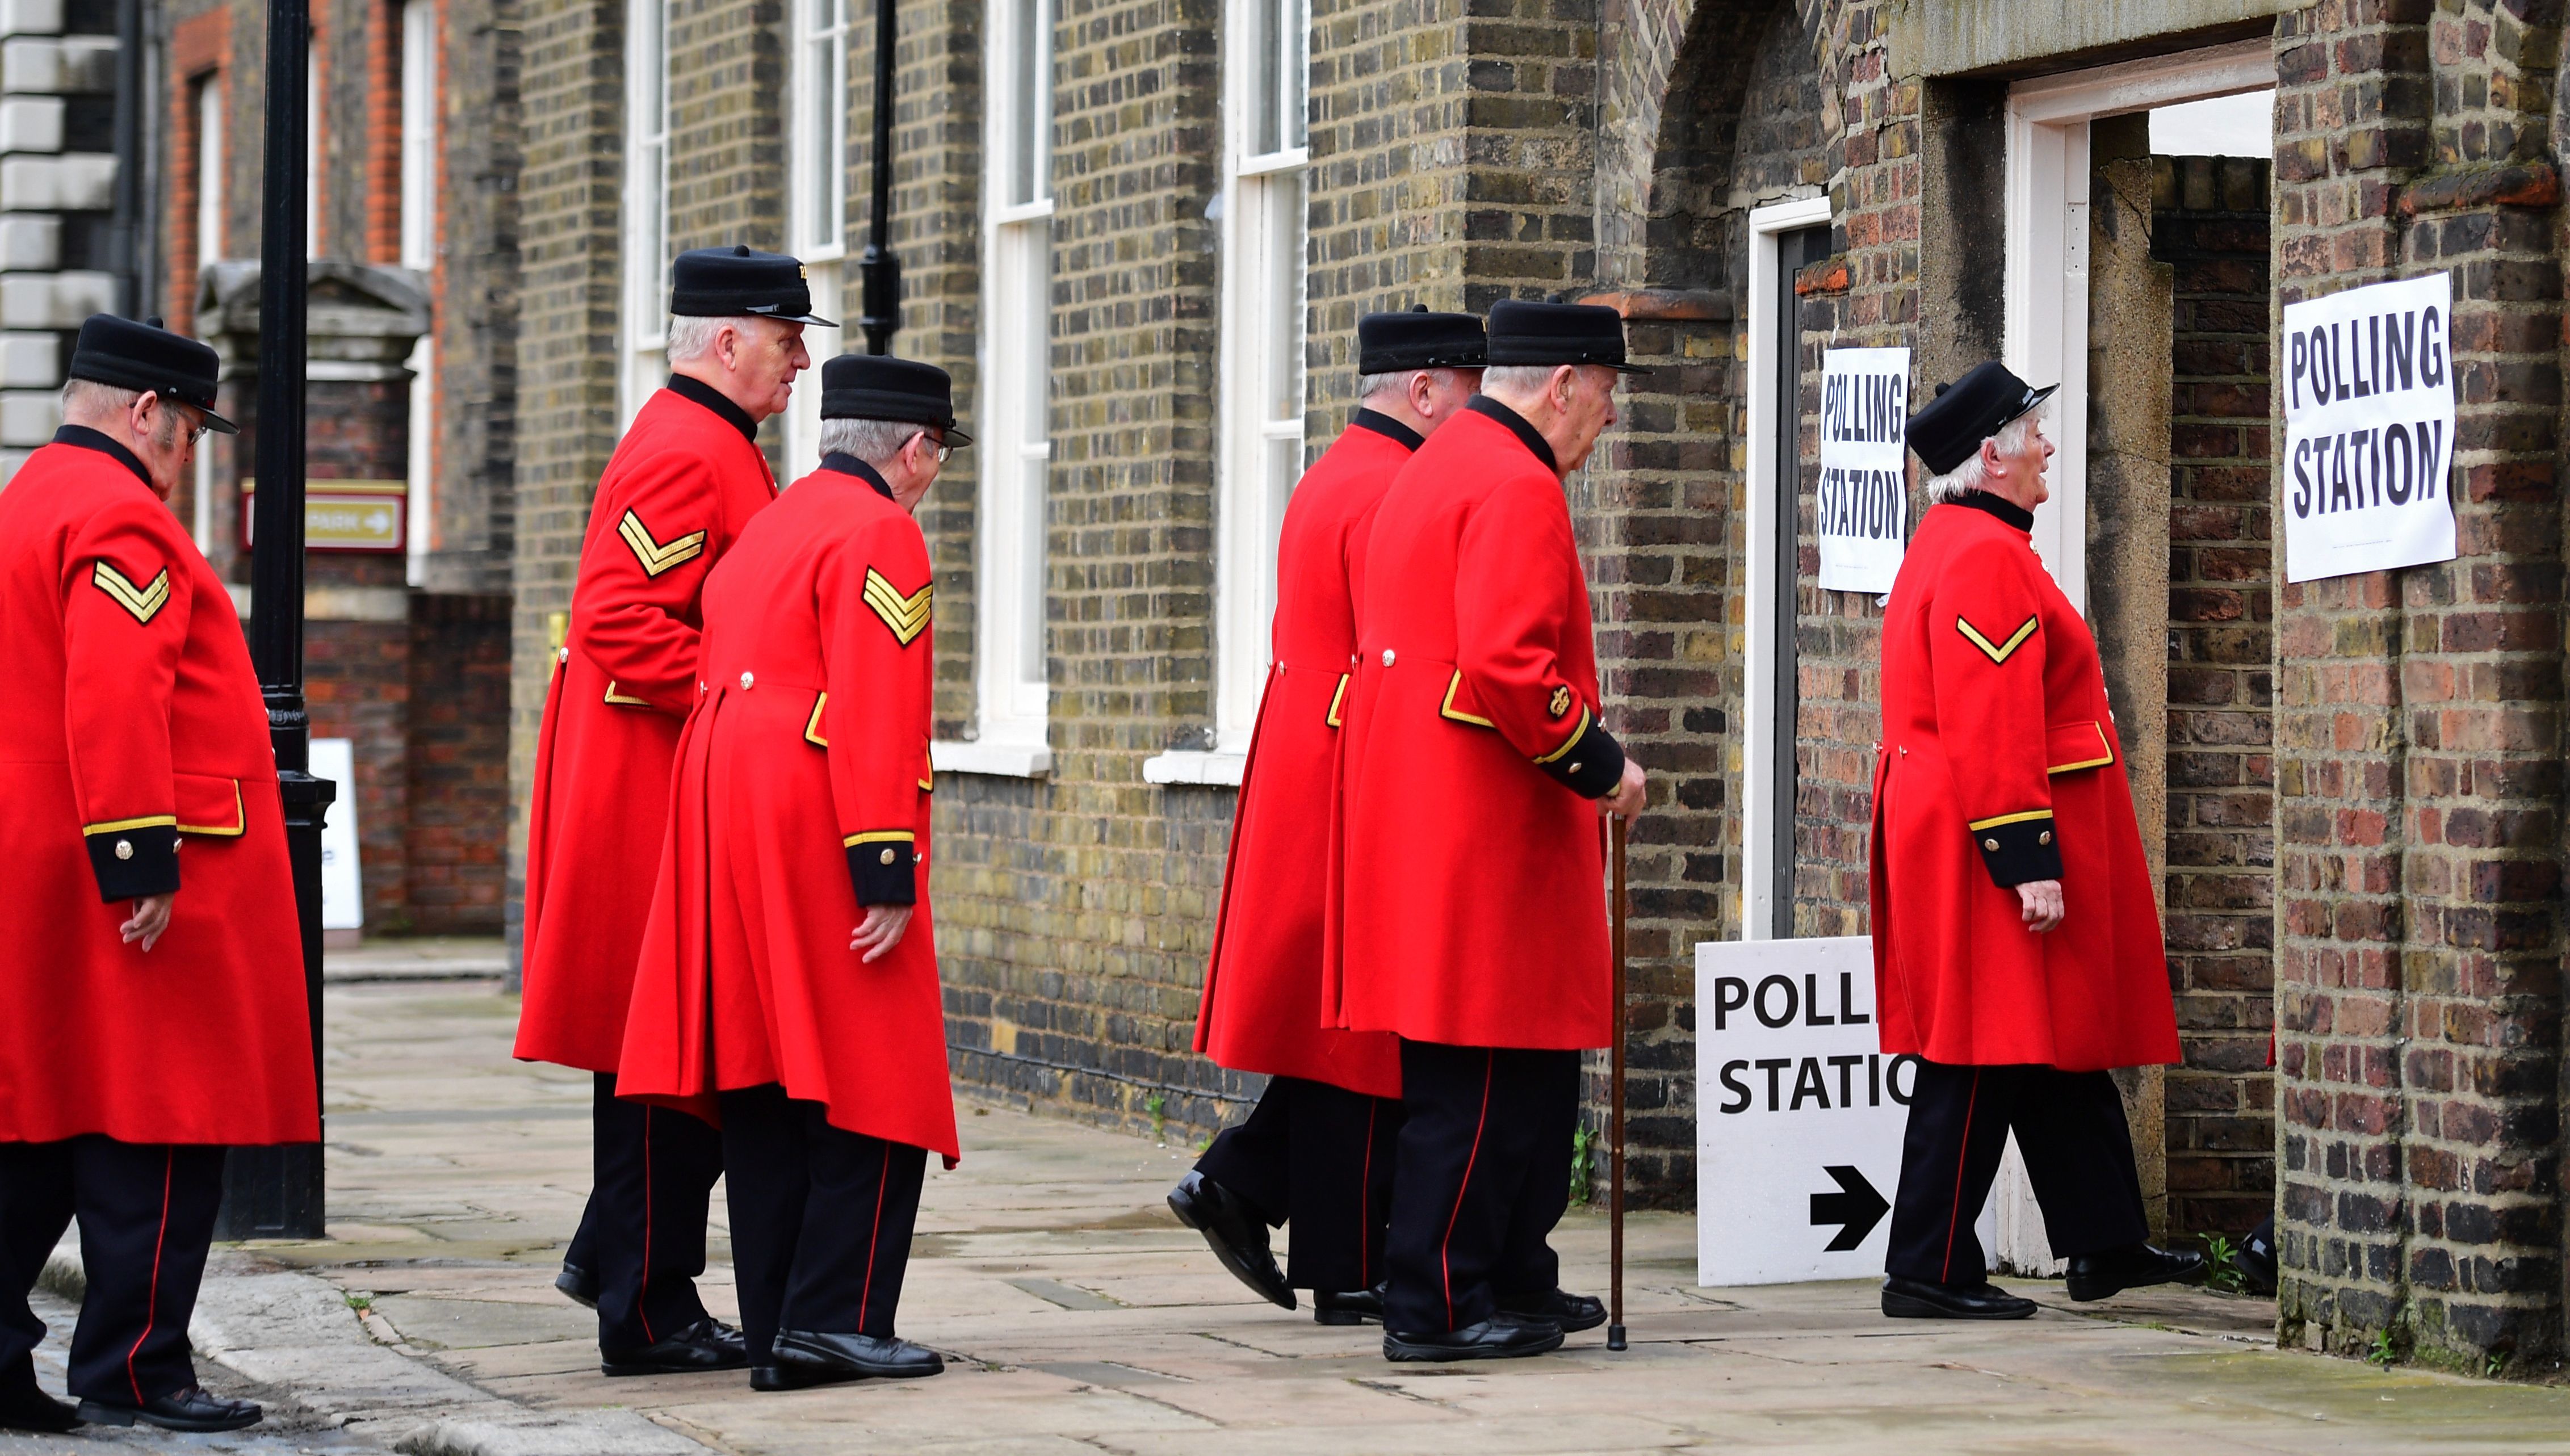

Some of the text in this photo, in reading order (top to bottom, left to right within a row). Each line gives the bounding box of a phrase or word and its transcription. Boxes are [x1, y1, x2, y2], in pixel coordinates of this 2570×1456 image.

[2291, 305, 2443, 409] POLLING
[1823, 373, 1901, 444] POLLING
[1821, 467, 1898, 540] STATION
[2294, 419, 2442, 519] STATION
[1714, 971, 1878, 1030] POLL
